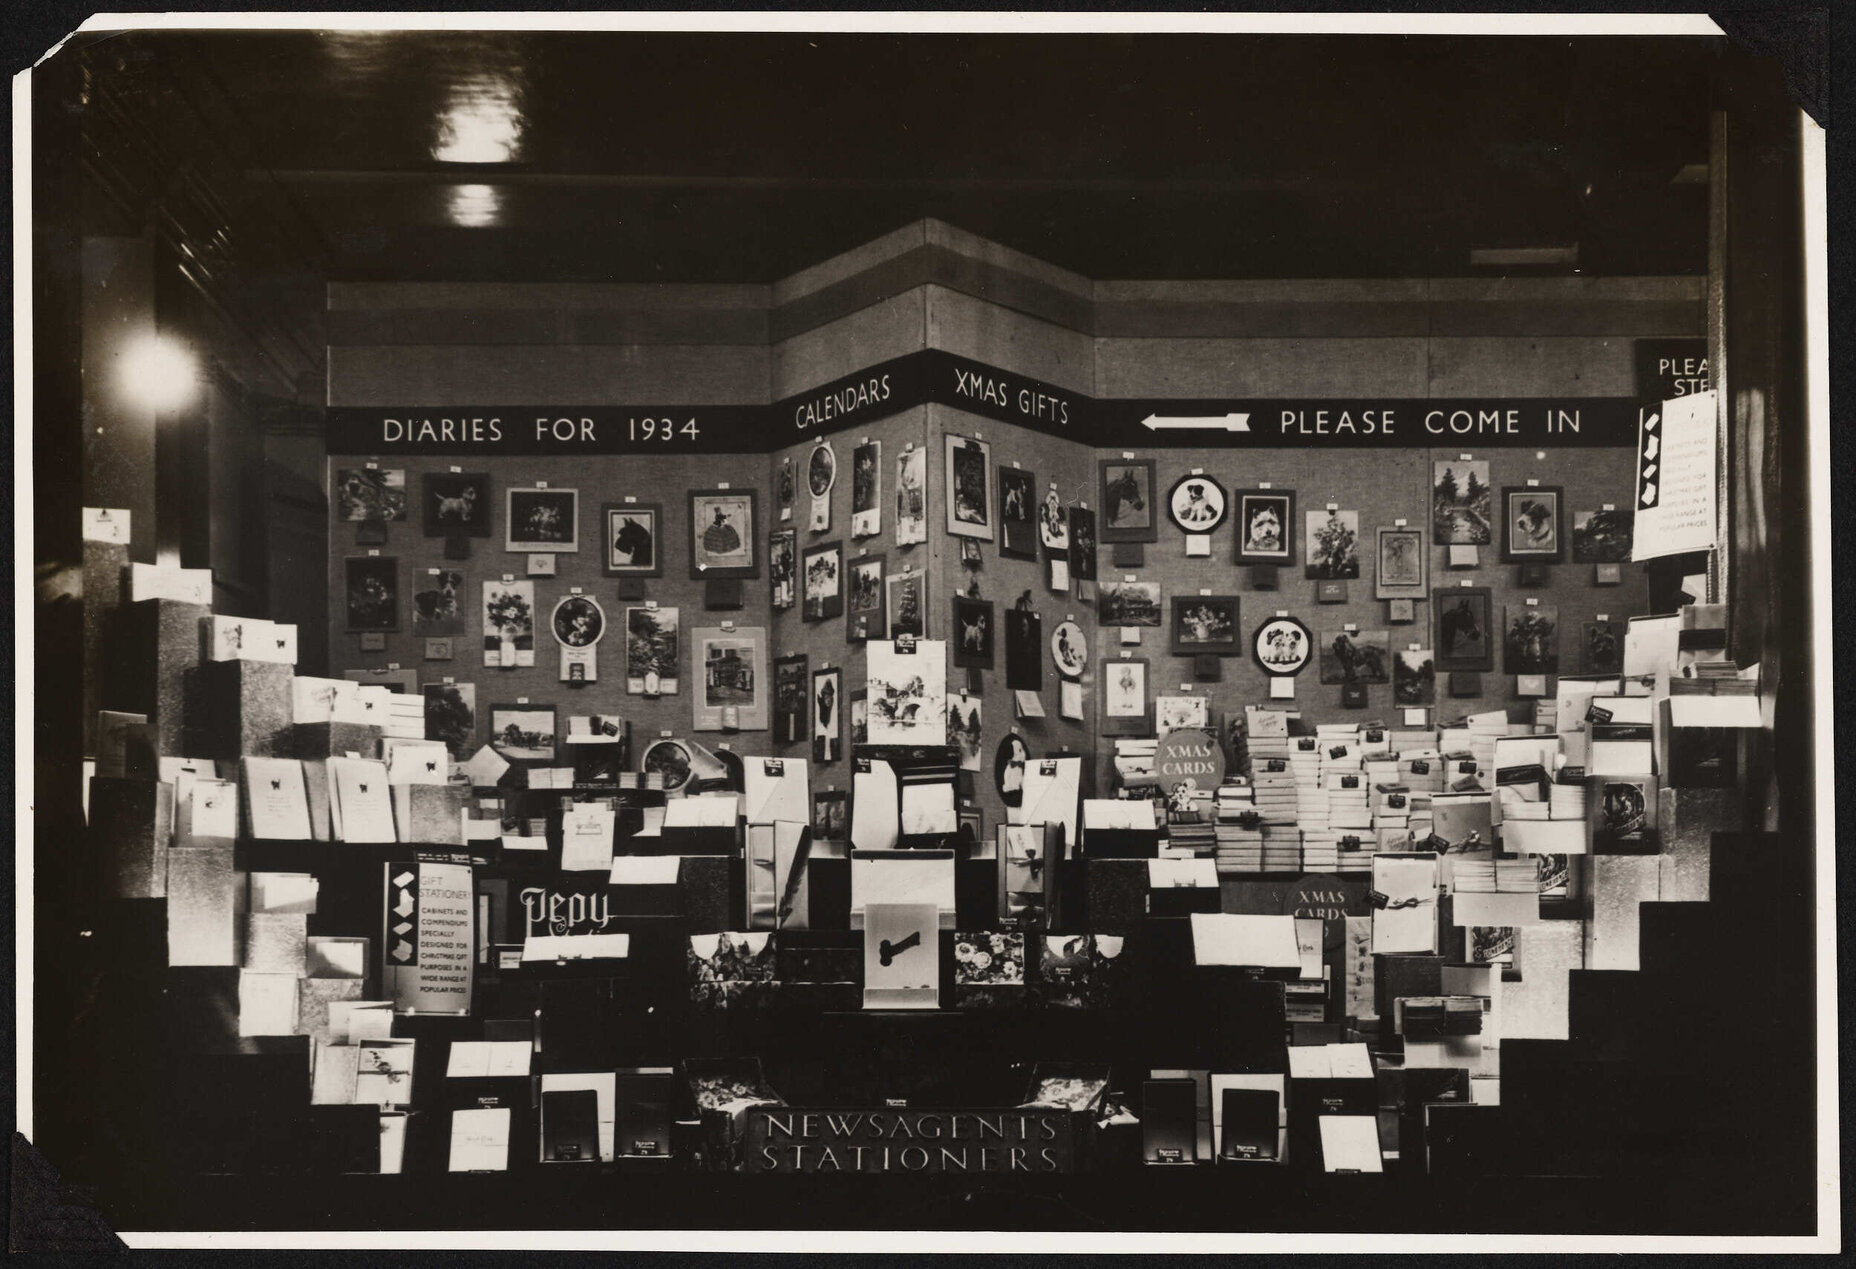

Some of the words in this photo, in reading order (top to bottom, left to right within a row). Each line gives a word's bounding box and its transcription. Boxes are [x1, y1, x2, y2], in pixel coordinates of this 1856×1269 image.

[795, 374, 890, 429] CALENDARS
[954, 368, 1007, 407] XMAS
[1018, 390, 1068, 424] GIFTS
[1281, 410, 1395, 433] PLEASE
[1425, 410, 1519, 433] COME
[1547, 410, 1580, 432] IN
[384, 418, 502, 442] DIARIES
[536, 418, 596, 441] FOR
[630, 418, 700, 441] 1934
[1166, 744, 1211, 758] XMAS
[1162, 761, 1215, 775] CARDS
[419, 888, 471, 900] STATIONER
[1299, 890, 1345, 903] XMAS
[421, 907, 454, 915] CABINETS
[1294, 907, 1349, 920] CARDS
[420, 929, 455, 938] SPECIALLY
[420, 941, 455, 949] DESIGNED
[420, 963, 453, 972] PURPOSES
[419, 986, 449, 994] POPULAR
[764, 1113, 1056, 1140] NEWSAGENTS
[762, 1145, 1056, 1172] STATIONERS
